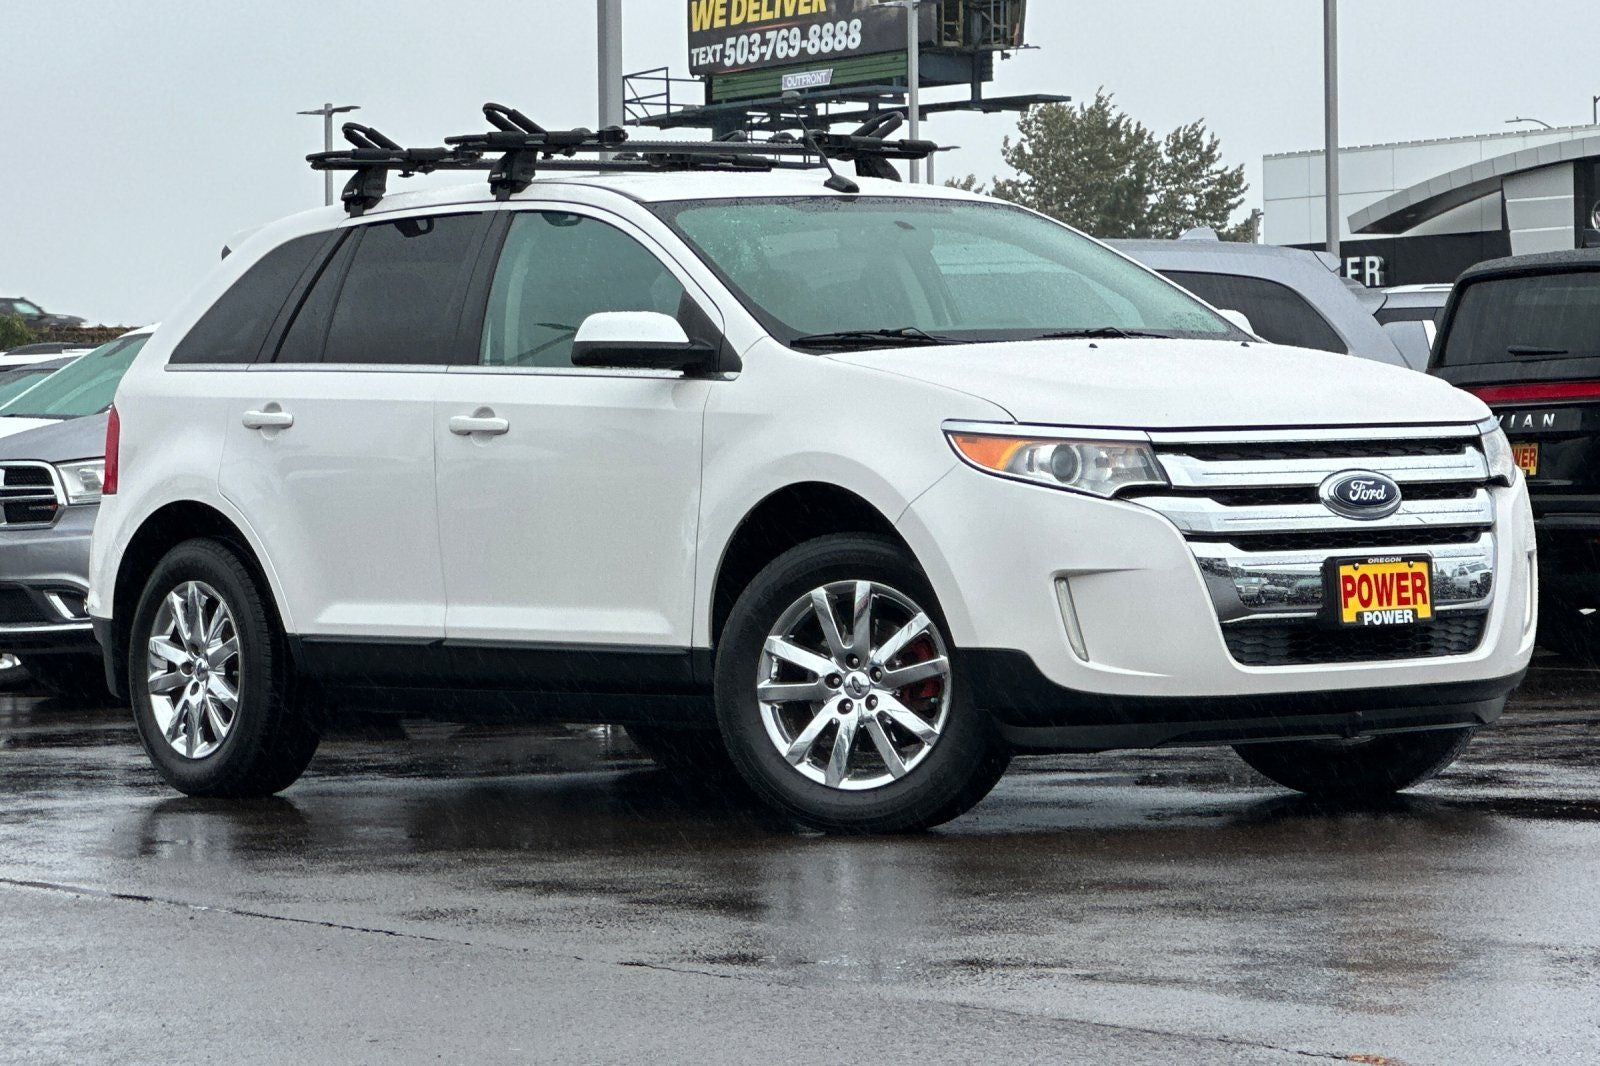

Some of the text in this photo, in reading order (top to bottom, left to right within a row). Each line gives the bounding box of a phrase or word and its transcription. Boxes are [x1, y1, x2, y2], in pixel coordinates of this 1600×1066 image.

[691, 0, 727, 32] WE
[691, 18, 862, 67] TEXT 503-769-8888
[786, 72, 827, 87] OUTFRONT
[1349, 480, 1387, 501] Ford
[1367, 556, 1402, 564] OREGON
[1341, 571, 1428, 609] POWER
[1363, 609, 1414, 626] POWER
